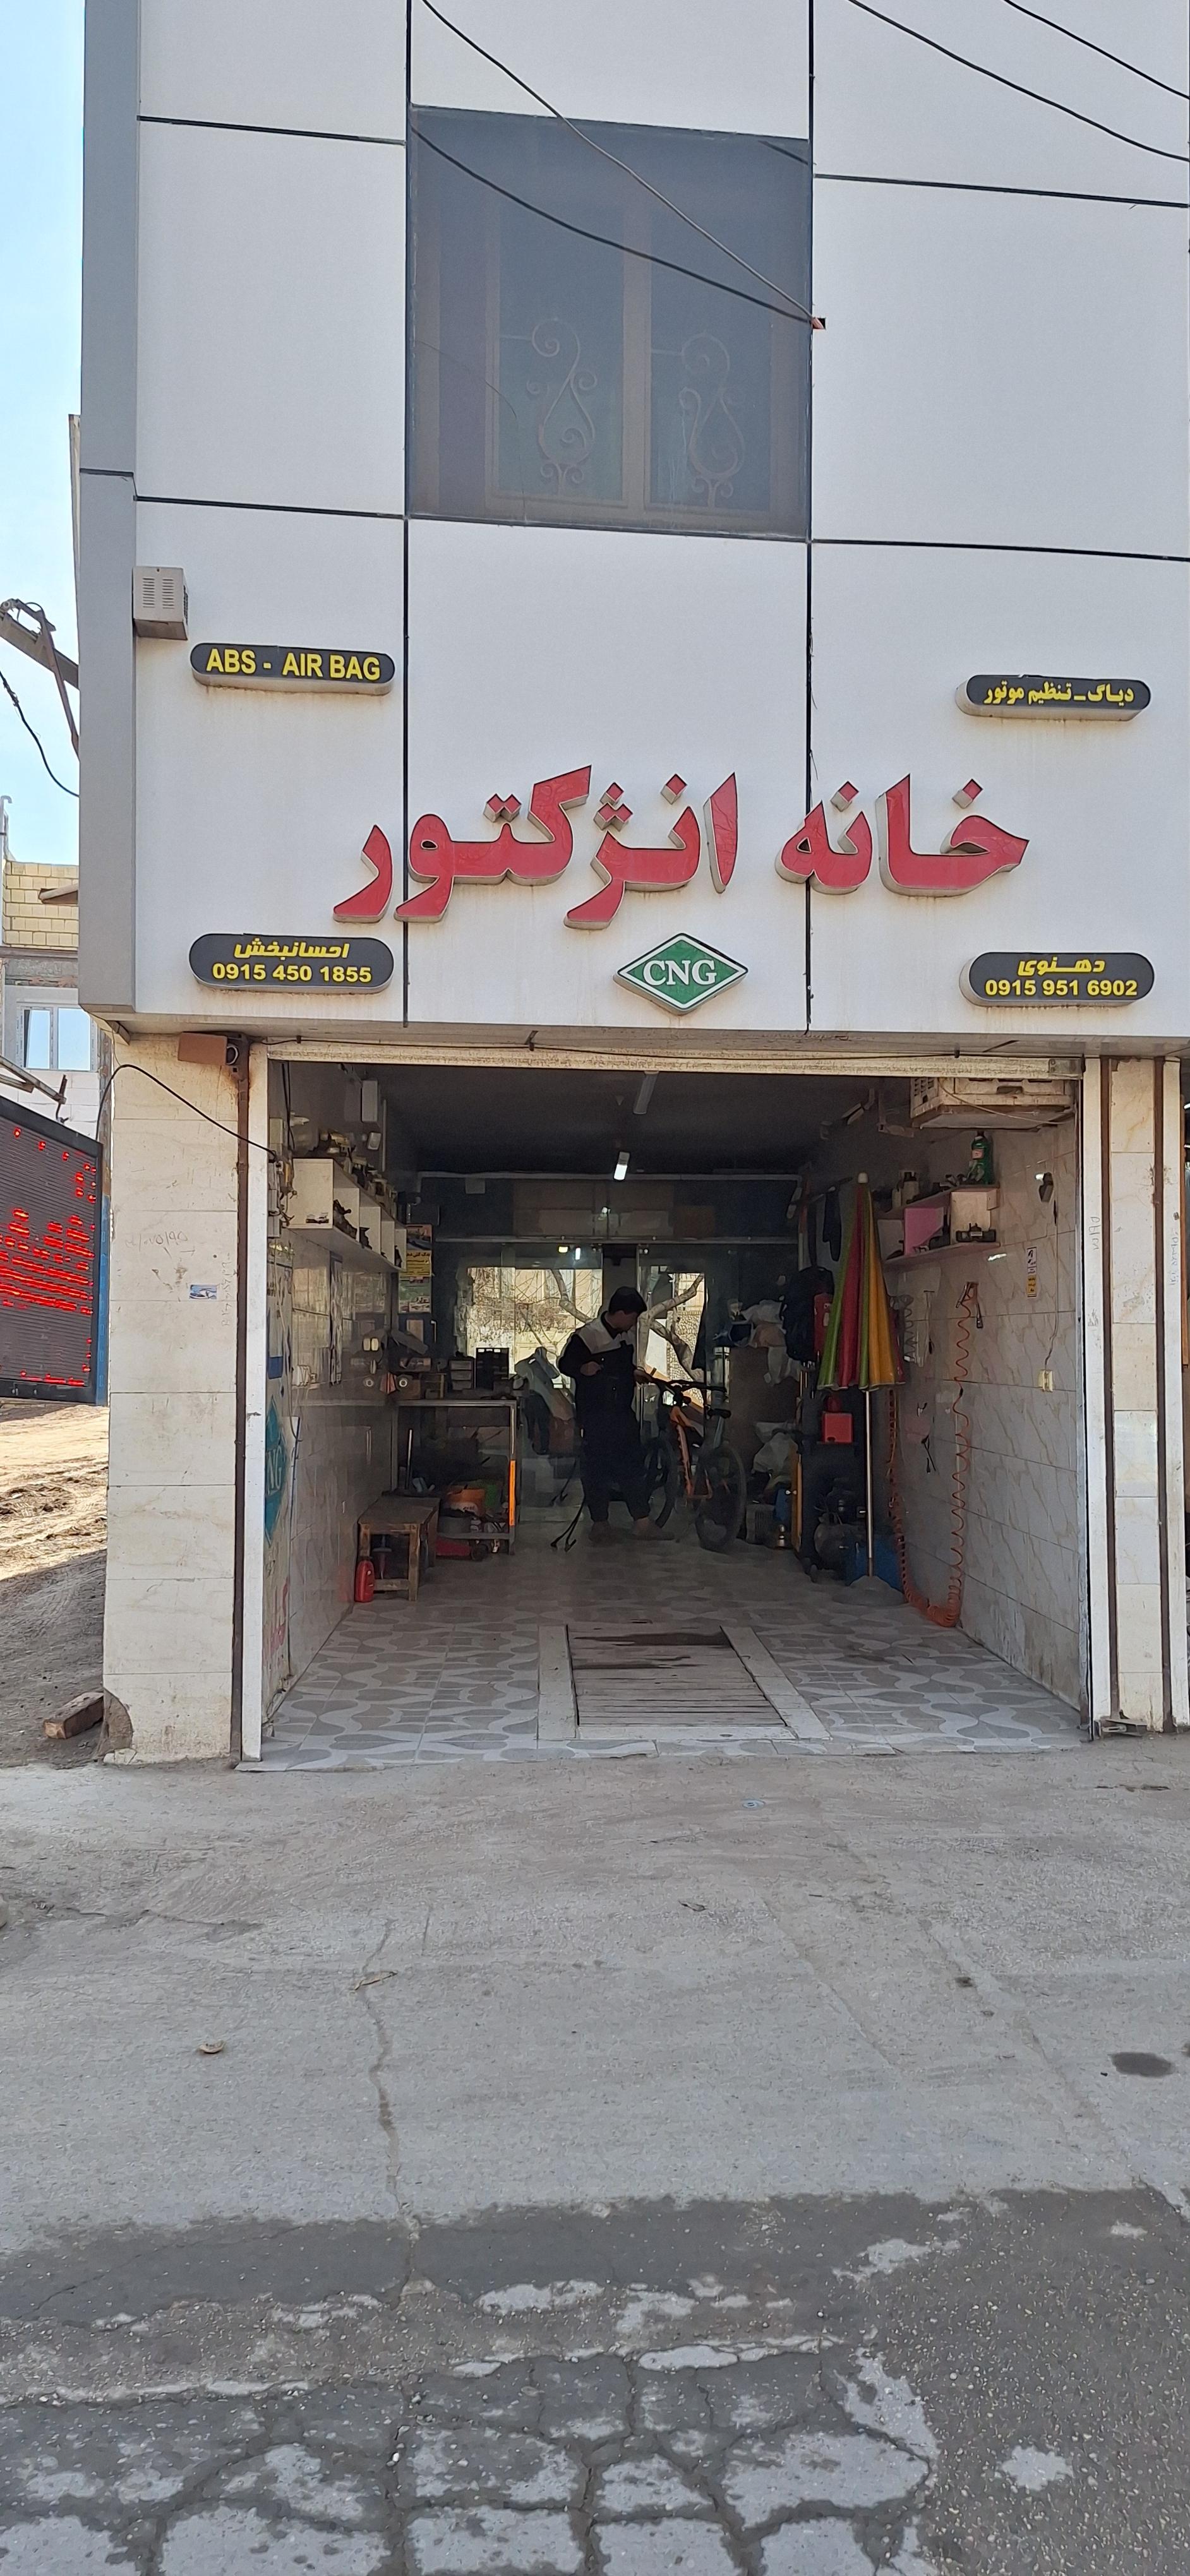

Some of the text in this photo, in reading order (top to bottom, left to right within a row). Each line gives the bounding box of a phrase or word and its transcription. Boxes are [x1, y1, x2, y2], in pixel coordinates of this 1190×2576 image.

[205, 648, 256, 674] ABS
[282, 652, 323, 677] AIR
[329, 654, 381, 681] BAG
[983, 680, 1025, 705] موتور
[1028, 681, 1072, 705] تنظیم
[1088, 683, 1134, 707] دیاگ
[333, 765, 1030, 926] خانه انژکتور
[233, 938, 350, 960] احسانبخش
[212, 963, 372, 983] 0915 450 1855
[642, 960, 717, 986] CNG
[1017, 958, 1105, 976] دهنوی
[985, 979, 1138, 996] 0915 951 6902
[266, 1445, 282, 1496] NG
